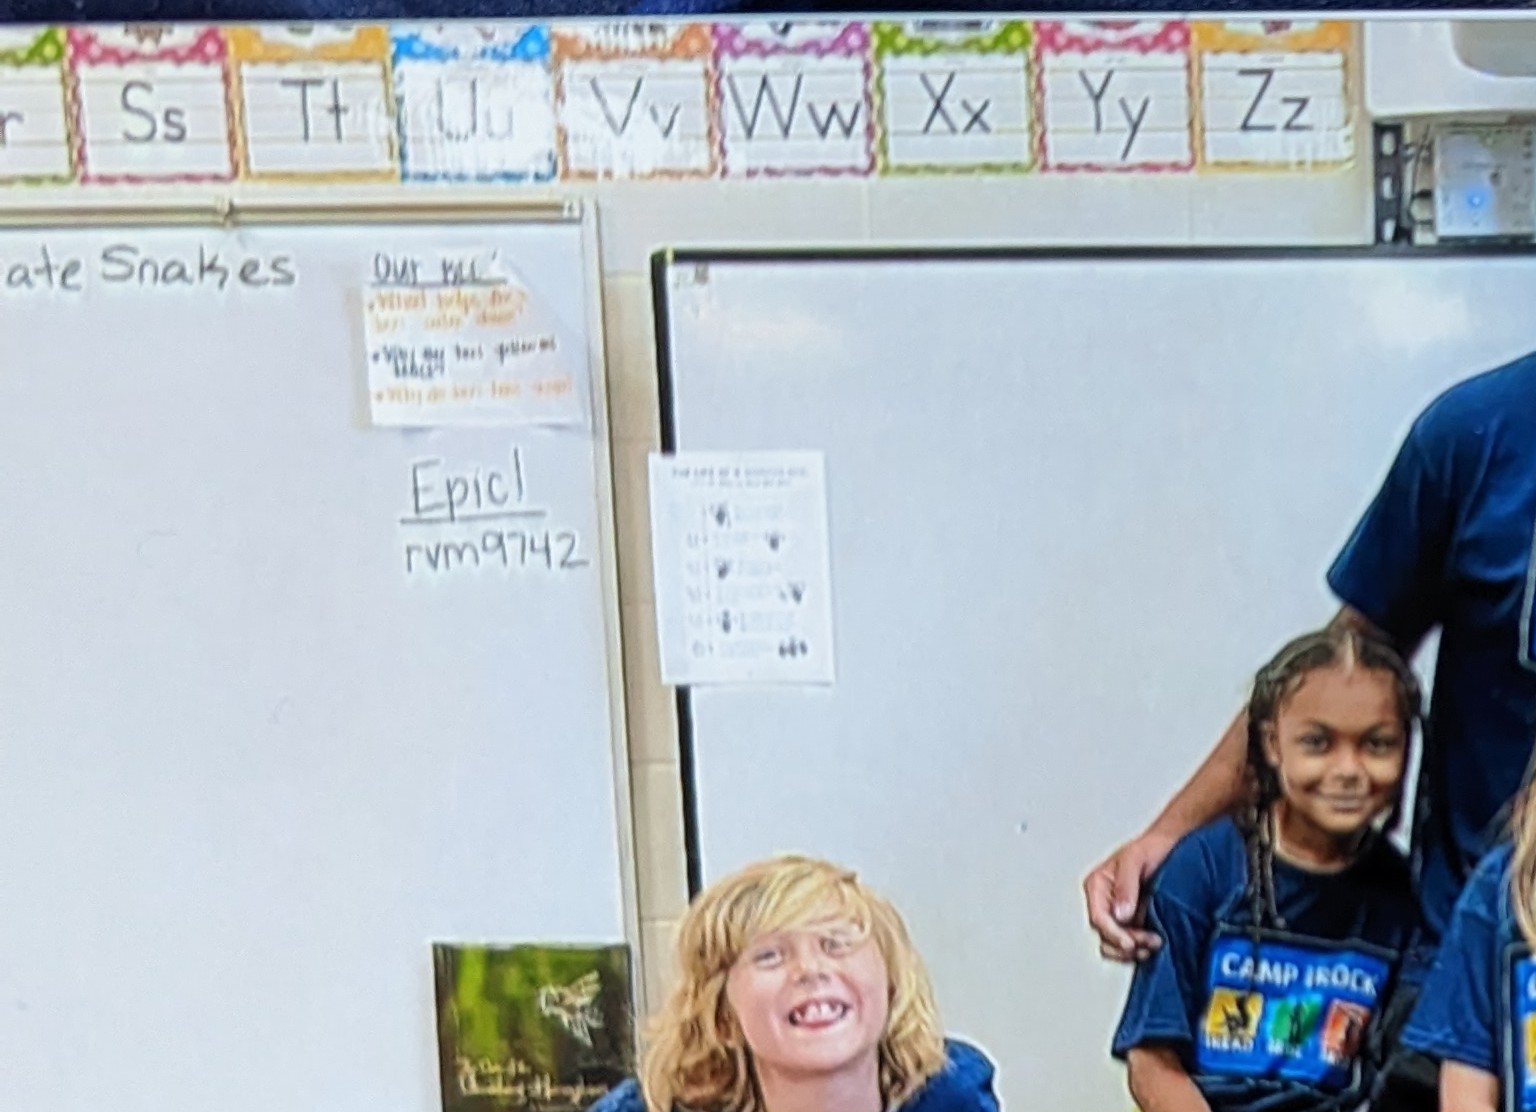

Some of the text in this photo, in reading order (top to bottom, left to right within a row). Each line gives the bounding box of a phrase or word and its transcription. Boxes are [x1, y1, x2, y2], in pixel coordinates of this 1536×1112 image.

[121, 80, 187, 143] Ss
[280, 77, 348, 143] Tt
[437, 80, 514, 143] Uu
[588, 76, 681, 139] Vv
[727, 72, 861, 140] Ww
[919, 71, 992, 135] Xx
[1079, 68, 1150, 160] Yy
[1237, 68, 1313, 132] Zz
[6, 243, 296, 291] ate Snakes
[406, 529, 590, 573] rvm9742
[1220, 951, 1300, 988] CAMP
